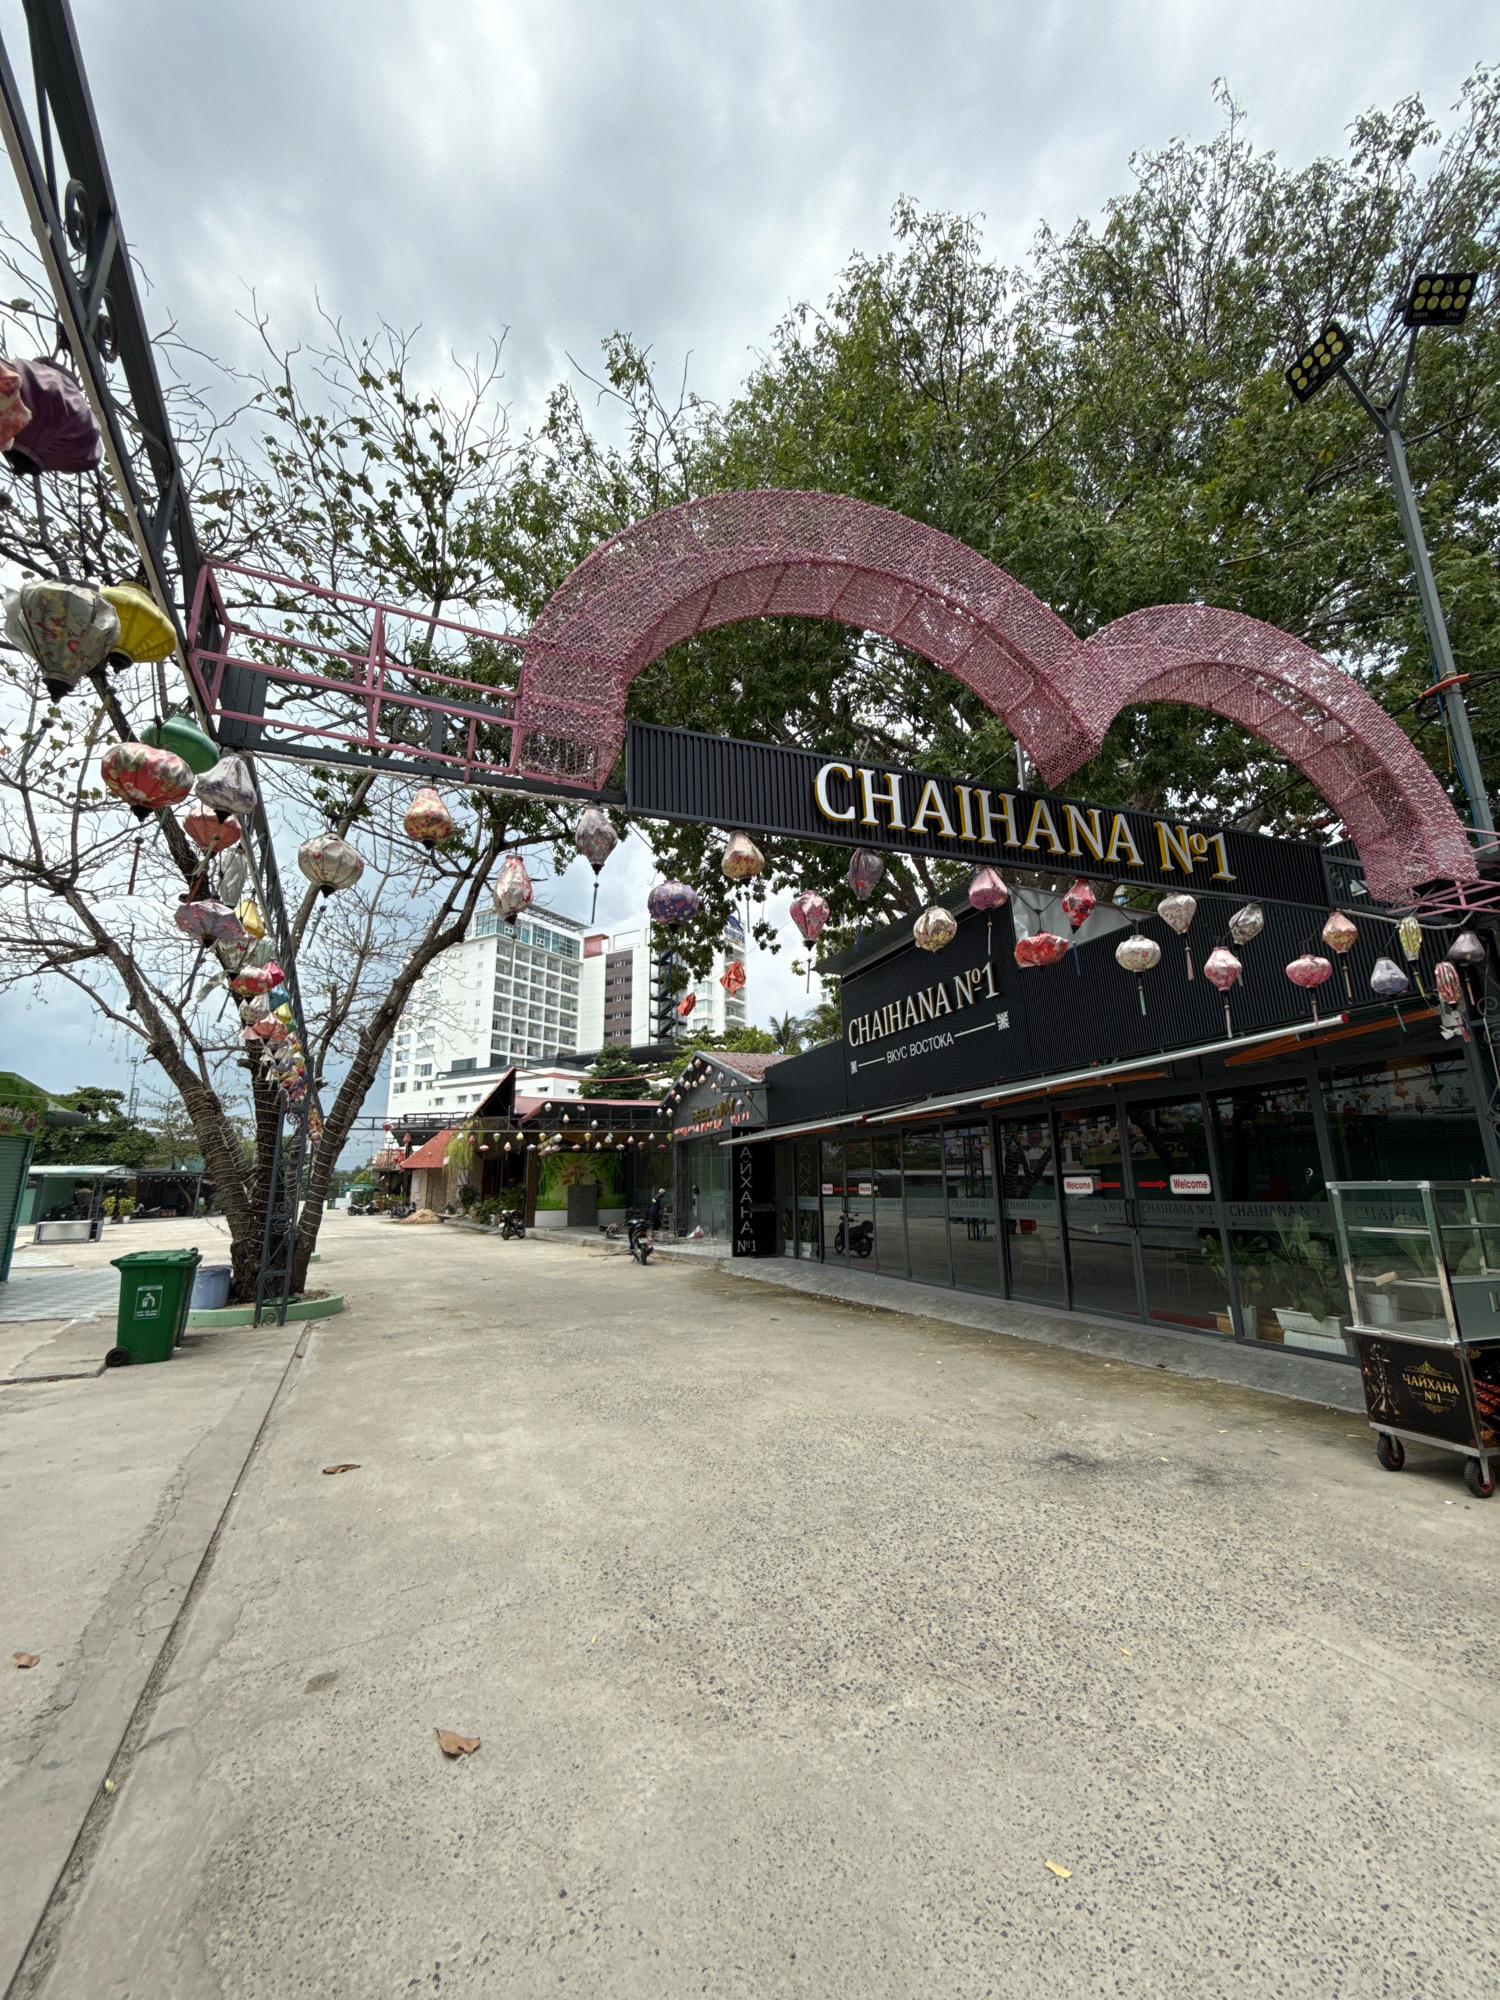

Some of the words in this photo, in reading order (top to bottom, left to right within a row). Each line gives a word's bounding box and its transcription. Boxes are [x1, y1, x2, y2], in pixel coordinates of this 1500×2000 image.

[814, 762, 1145, 867] CHAIHANA
[848, 982, 953, 1047] CHAIHANA
[886, 1045, 908, 1064] ВКУС
[909, 1032, 955, 1057] ВОСТОКА
[1065, 1181, 1092, 1190] Welcome
[1172, 1179, 1208, 1190] Welcome
[1141, 1203, 1195, 1215] CHAIHANA
[1401, 1373, 1461, 1396] ЧАЙХАНА
